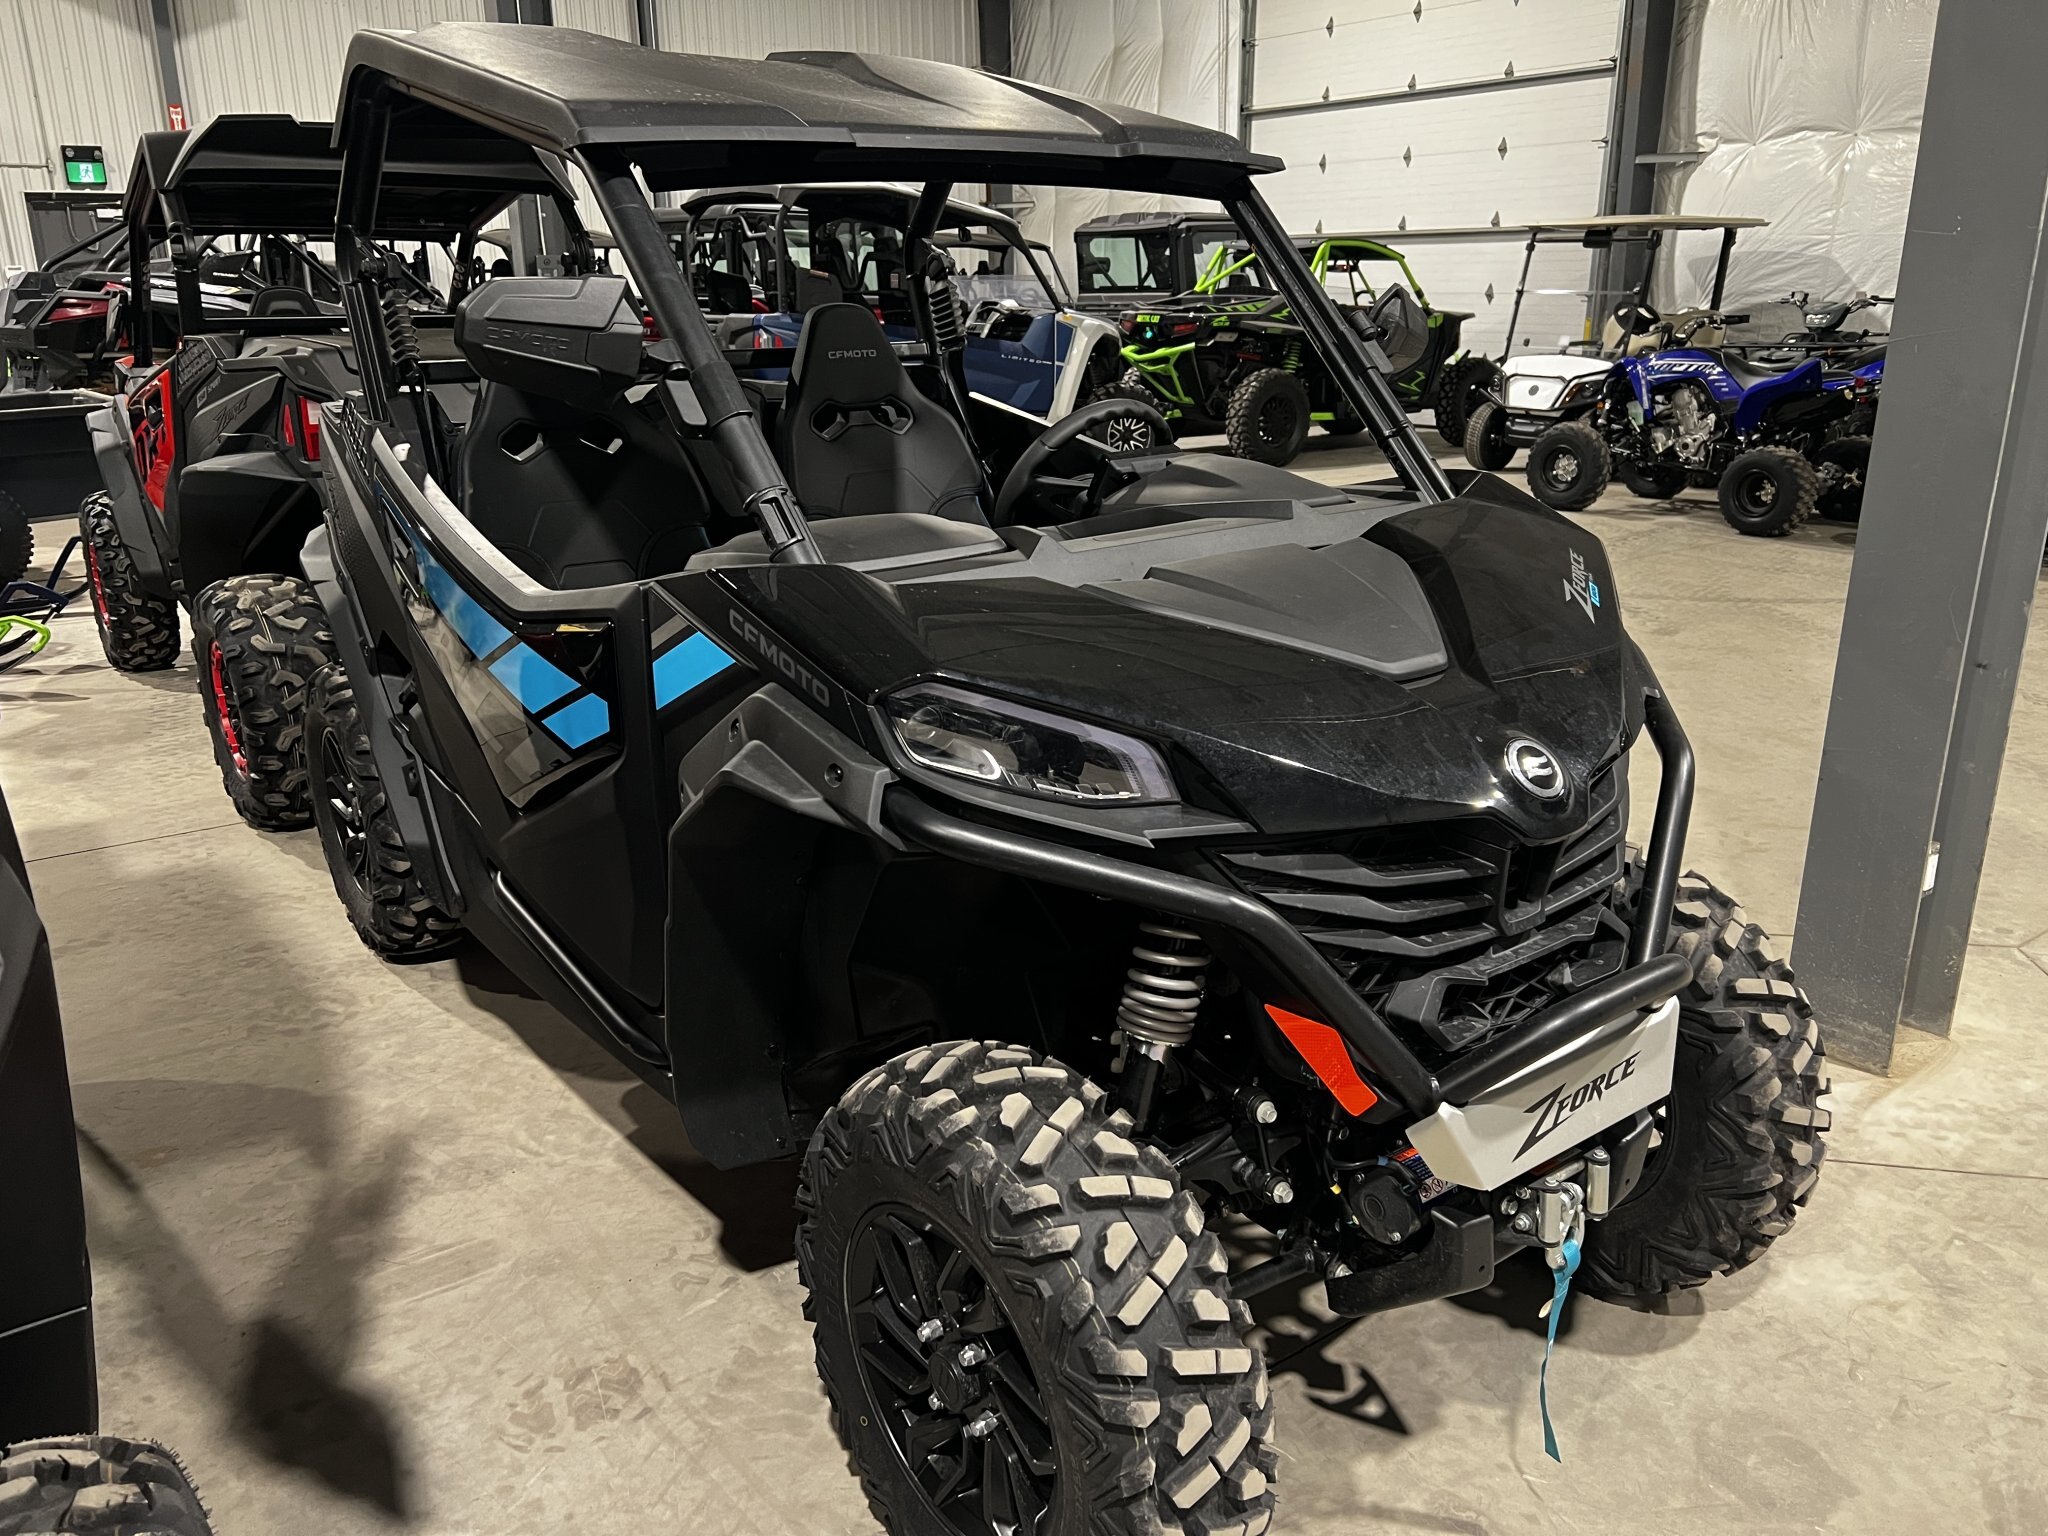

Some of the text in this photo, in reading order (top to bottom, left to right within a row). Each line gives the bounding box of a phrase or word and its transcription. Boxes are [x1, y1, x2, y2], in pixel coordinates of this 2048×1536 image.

[828, 349, 877, 359] CFMOTO
[1001, 354, 1042, 363] LIMITED
[729, 609, 830, 708] CFMOTO
[1512, 1050, 1642, 1163] ZFORCE
